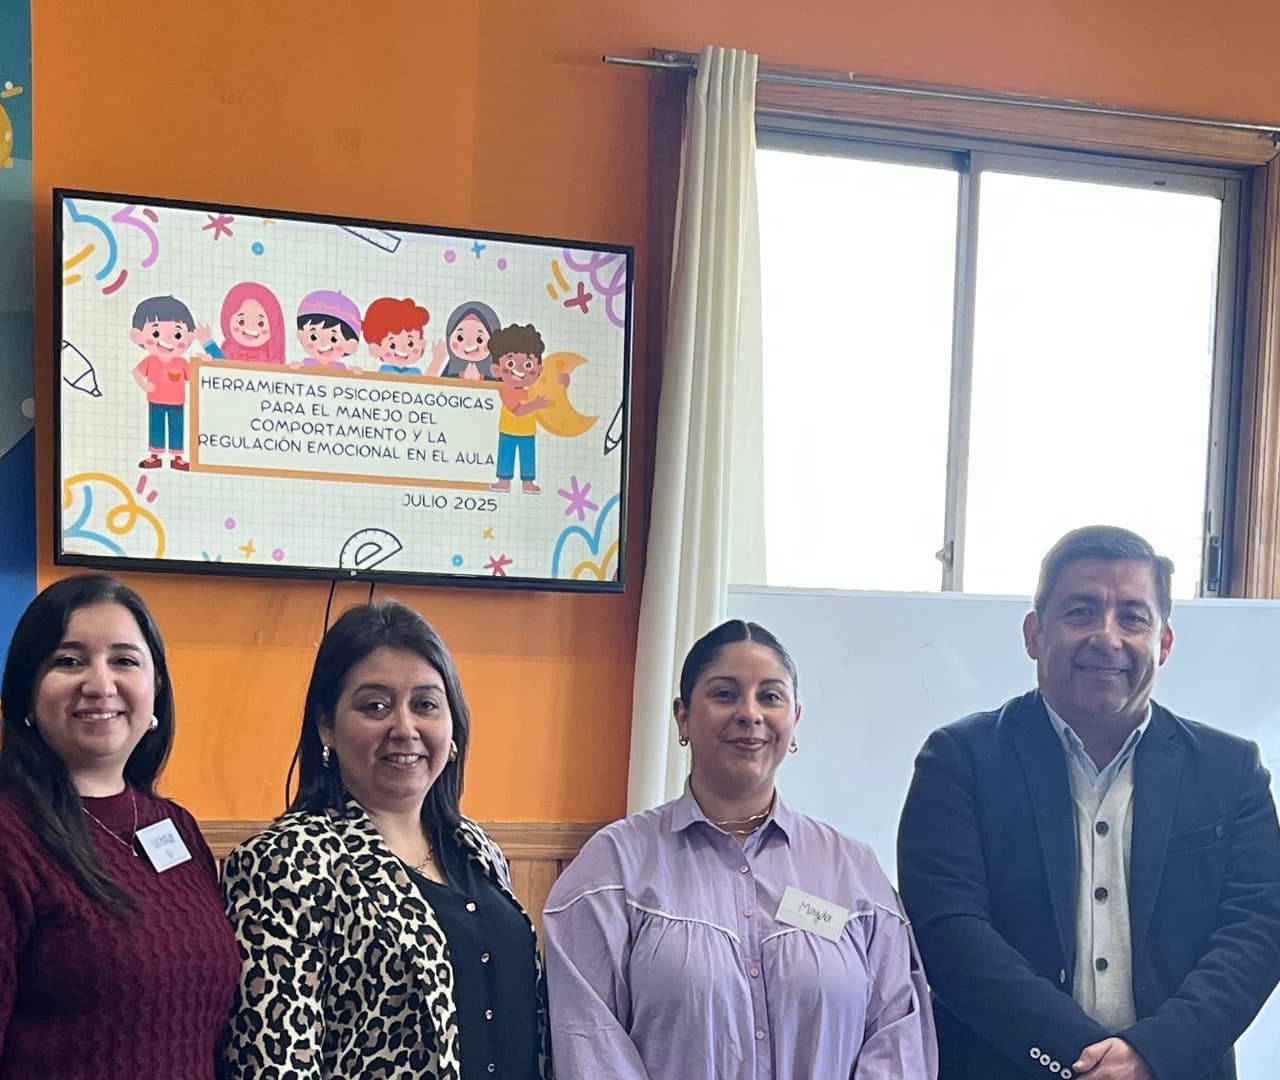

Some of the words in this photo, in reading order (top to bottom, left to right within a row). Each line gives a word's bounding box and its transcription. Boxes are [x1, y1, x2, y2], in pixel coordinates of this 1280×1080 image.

[201, 375, 327, 399] HERRAMIENTAS
[333, 386, 494, 411] PSICOPEDAGÓGICAS
[260, 400, 306, 416] PARA
[312, 404, 329, 417] EL
[336, 406, 403, 423] MANEJO
[408, 411, 438, 425] DEL
[250, 418, 406, 442] COMPORTAMIENTO
[412, 430, 422, 443] Y
[427, 431, 447, 444] LA
[198, 433, 302, 454] REGULACIÓN
[307, 440, 401, 460] EMOCIONAL
[407, 448, 426, 462] EN
[432, 450, 449, 463] EL
[455, 451, 495, 466] AULA
[402, 494, 447, 509] JULIO
[454, 497, 498, 512] 2025
